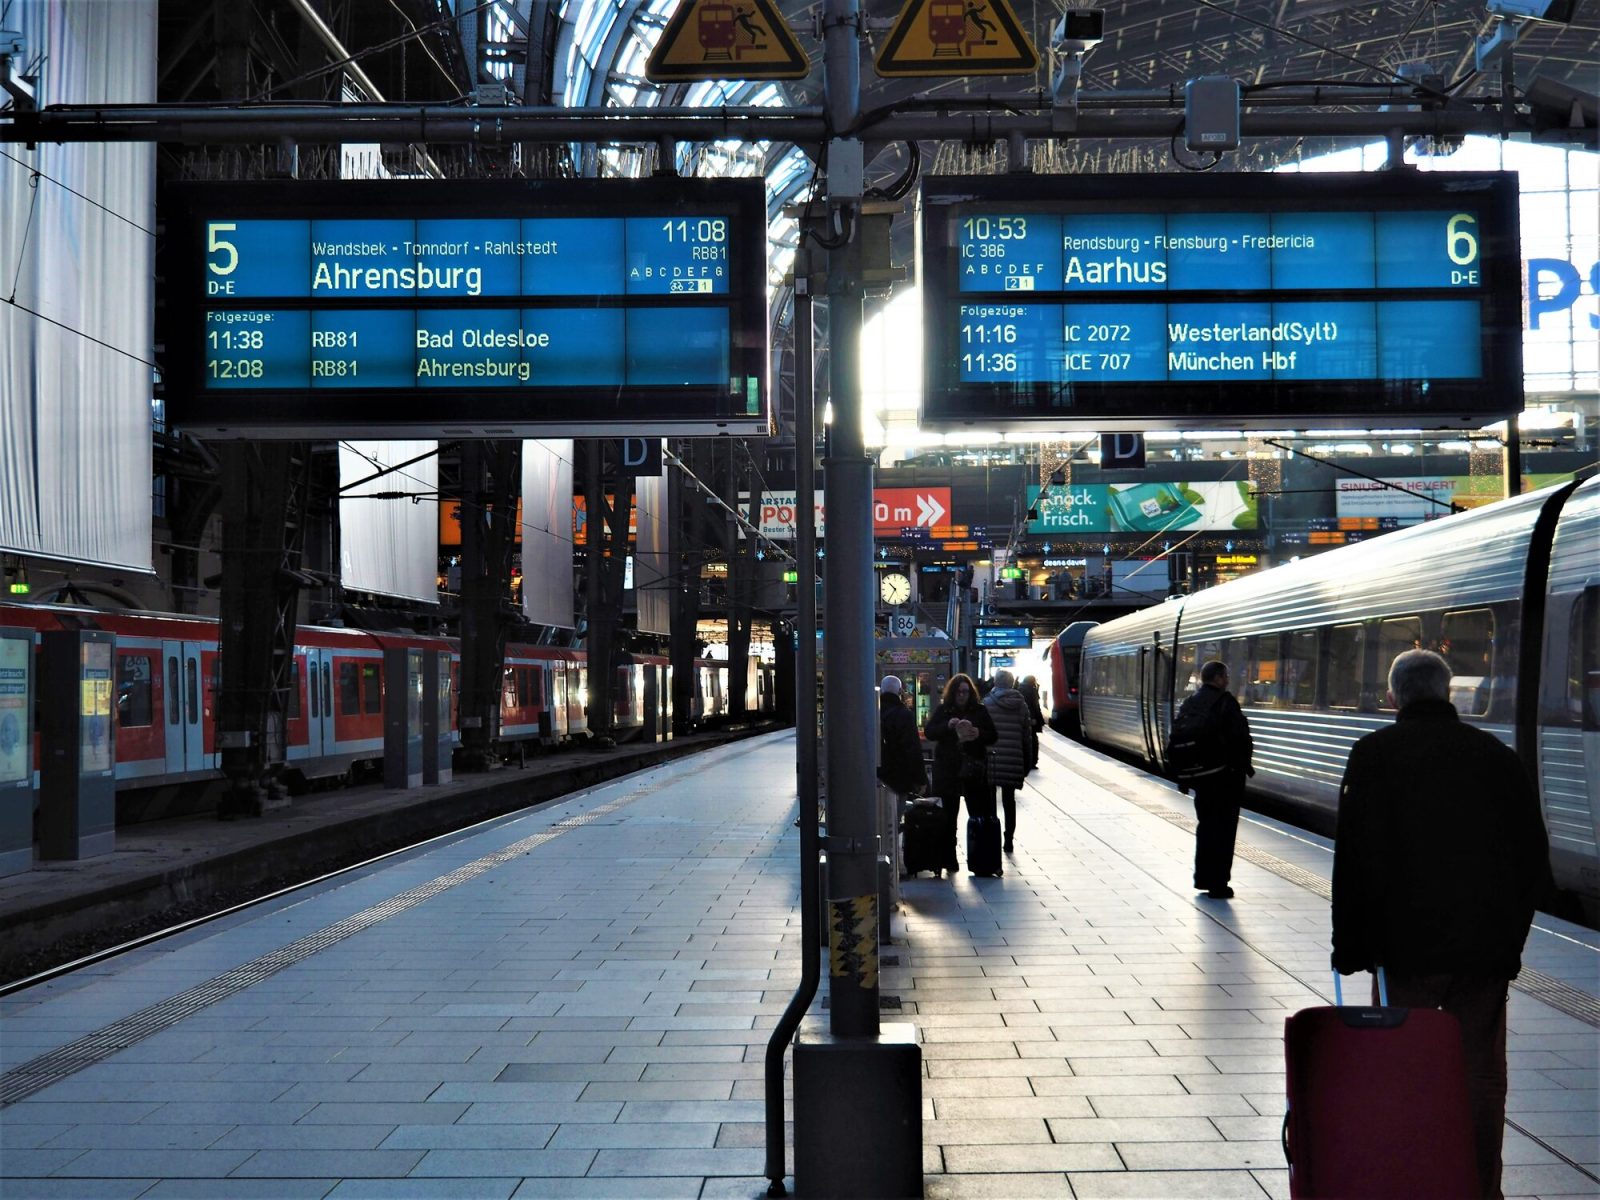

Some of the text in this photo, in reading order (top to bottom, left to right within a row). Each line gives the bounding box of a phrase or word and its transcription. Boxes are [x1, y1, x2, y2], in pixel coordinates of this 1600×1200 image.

[663, 220, 726, 243] 11:08
[963, 218, 1027, 240] 10:53
[1064, 236, 1139, 253] Rendsburg
[1154, 235, 1227, 252] Flensburg
[1242, 235, 1315, 248] Fredericia
[1446, 213, 1477, 265] 6
[208, 223, 239, 275] 5
[312, 241, 387, 256] Wandsbek
[403, 241, 469, 256] Tonndorf
[485, 241, 558, 255] Rahlstedt
[693, 246, 726, 260] RB81
[962, 244, 1005, 258] IC 386
[630, 267, 723, 277] A B C D E F G
[966, 264, 1044, 274] A B C D E F
[1064, 256, 1167, 284] Aarhus
[312, 262, 482, 296] Ahrensburg
[688, 282, 695, 291] 2
[1010, 279, 1017, 288] 2
[1451, 271, 1478, 285] D-E
[208, 281, 235, 295] D-E
[207, 311, 275, 324] Folgezüge:
[960, 306, 1027, 318] Folgezüge:
[208, 330, 264, 350] 11:38
[312, 331, 358, 348] RB81
[416, 329, 549, 348] Bad Oldesloe
[962, 324, 1017, 343] 11:16
[1065, 325, 1131, 342] IC 2072
[1168, 322, 1337, 345] Westerland(Sylt)
[208, 360, 264, 379] 12:08
[312, 360, 358, 376] RB81
[416, 358, 530, 381] Ahrensburg
[962, 353, 1017, 372] 11:36
[1065, 354, 1131, 371] ICE 707
[1168, 351, 1297, 371] München Hbf
[624, 437, 647, 465] D
[1115, 432, 1138, 458] D
[1340, 481, 1457, 491] SINUSIIS HEVERT
[1043, 489, 1096, 505] Knack.
[894, 507, 911, 521] m
[1044, 509, 1093, 526] Frisch.
[898, 617, 913, 629] 86
